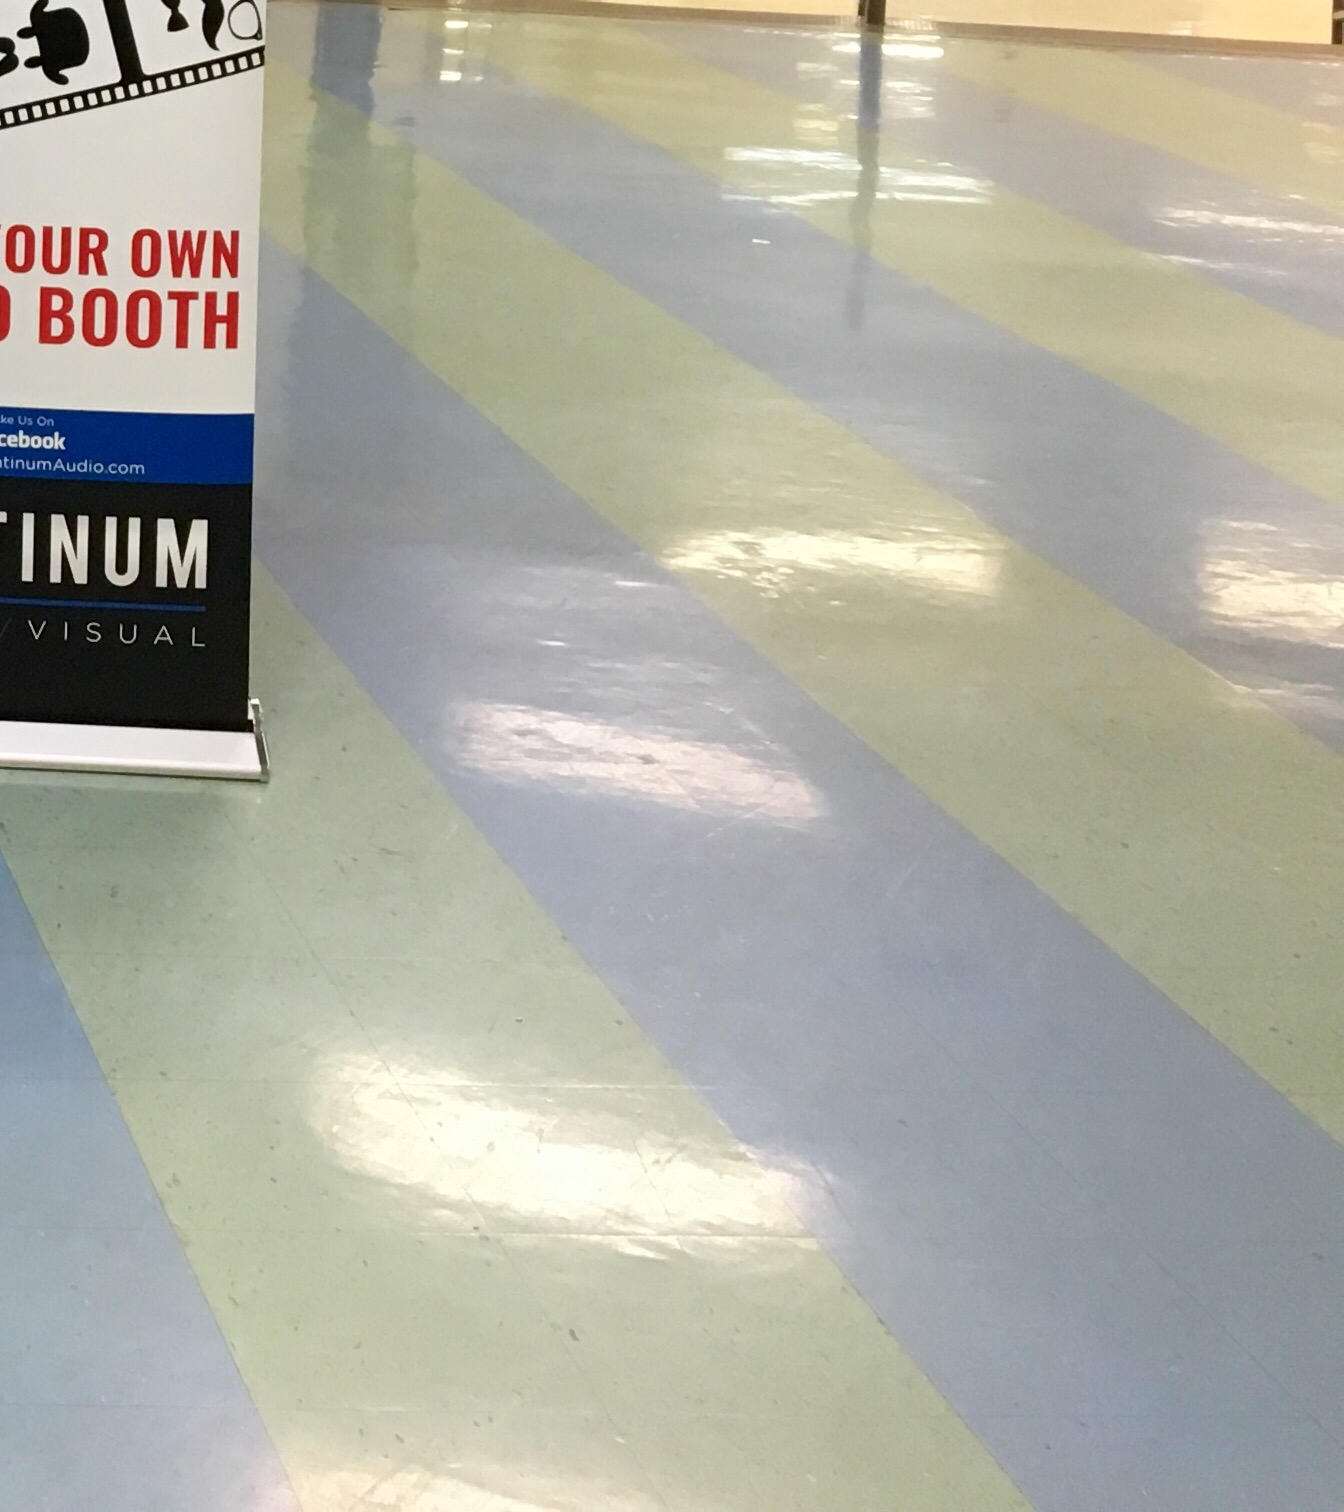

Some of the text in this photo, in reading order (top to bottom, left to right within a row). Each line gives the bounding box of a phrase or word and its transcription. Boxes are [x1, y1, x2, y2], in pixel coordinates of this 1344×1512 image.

[131, 229, 240, 279] OWN
[38, 286, 239, 350] BOOTH
[18, 415, 33, 426] Us
[36, 416, 55, 427] On
